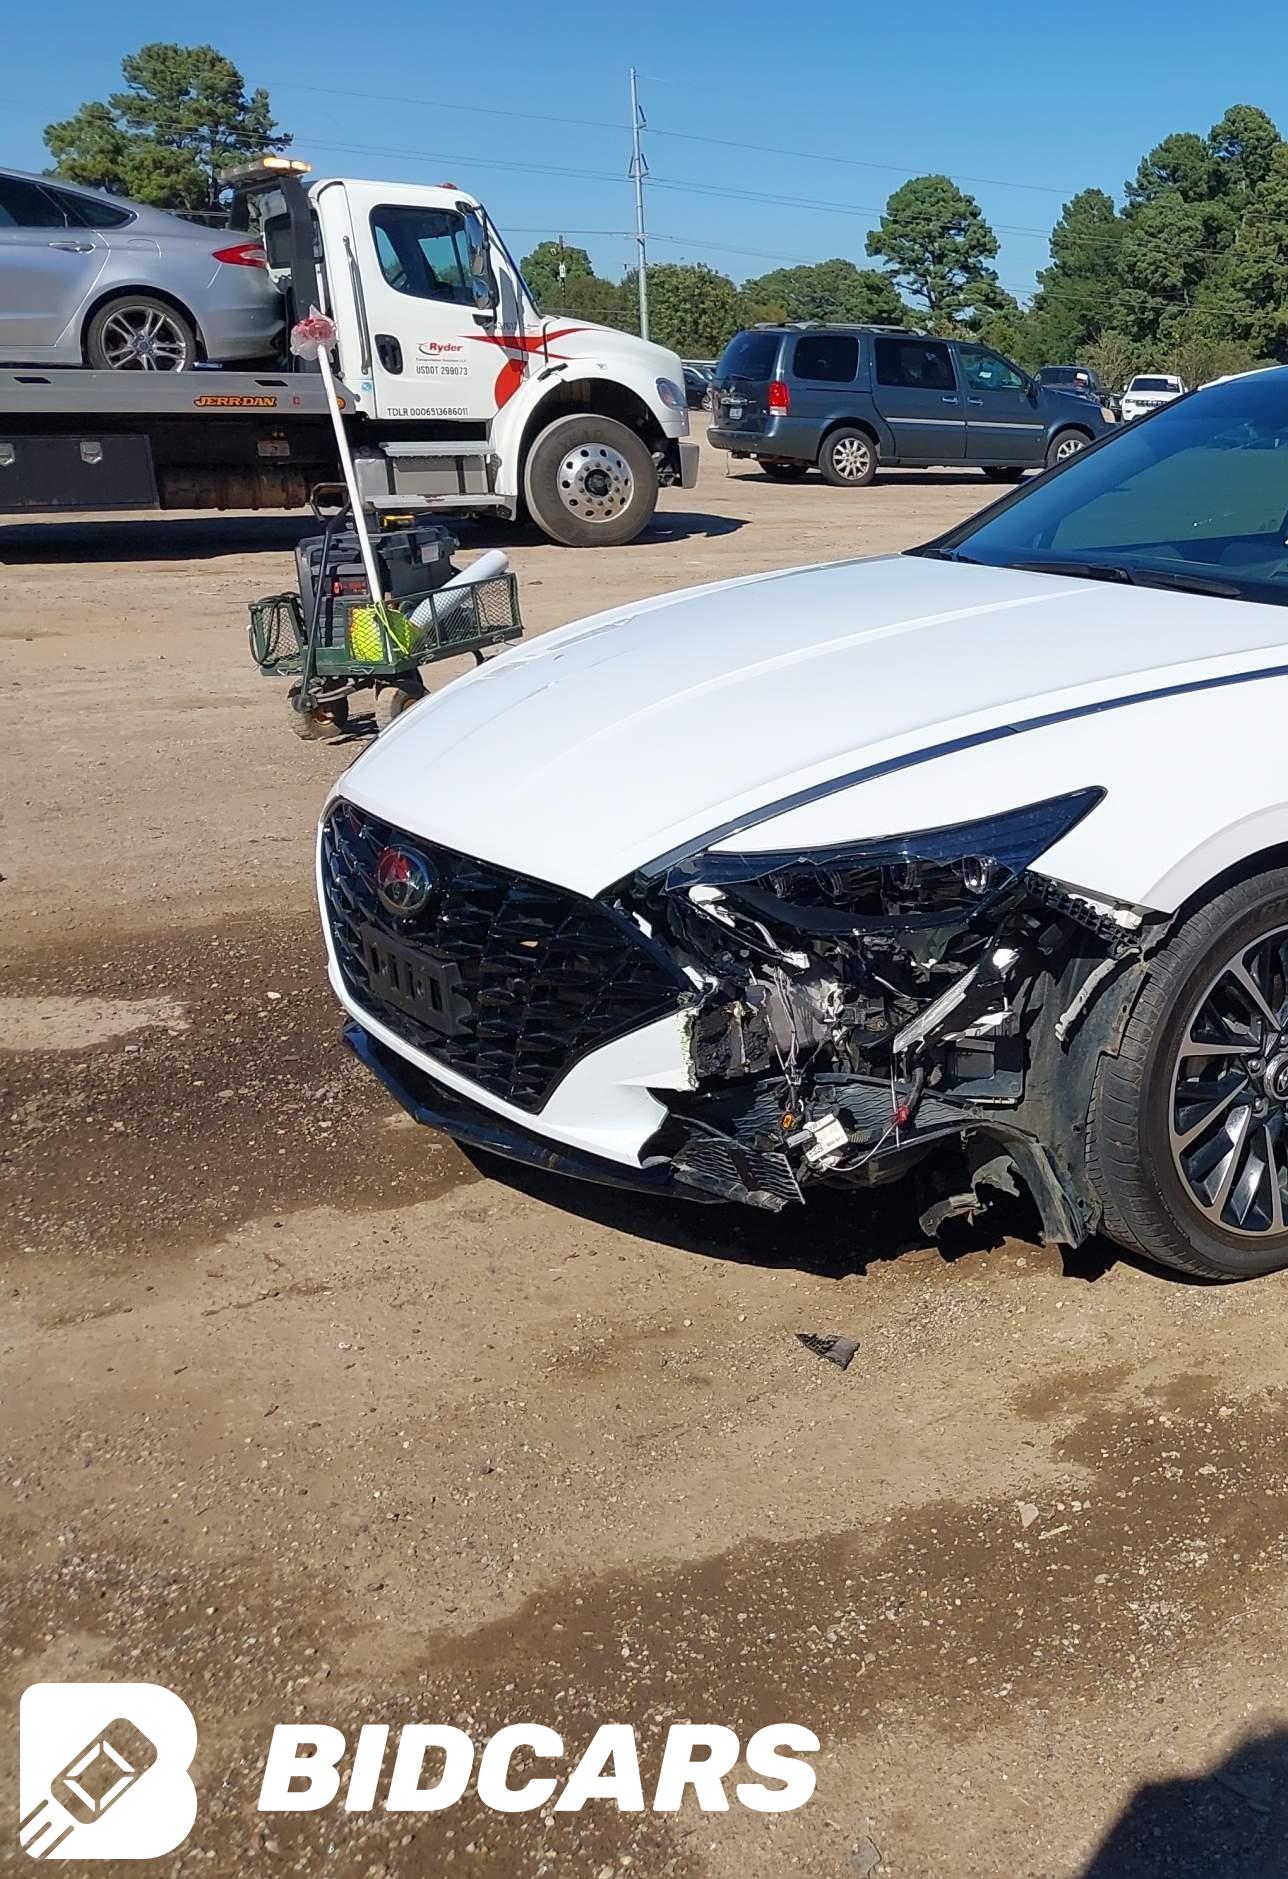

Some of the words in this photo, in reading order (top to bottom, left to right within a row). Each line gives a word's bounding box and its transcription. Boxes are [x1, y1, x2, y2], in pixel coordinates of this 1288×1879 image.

[429, 342, 463, 353] Ryder
[416, 365, 439, 375] USDOT
[440, 366, 468, 376] 299073
[387, 407, 409, 417] TDLR
